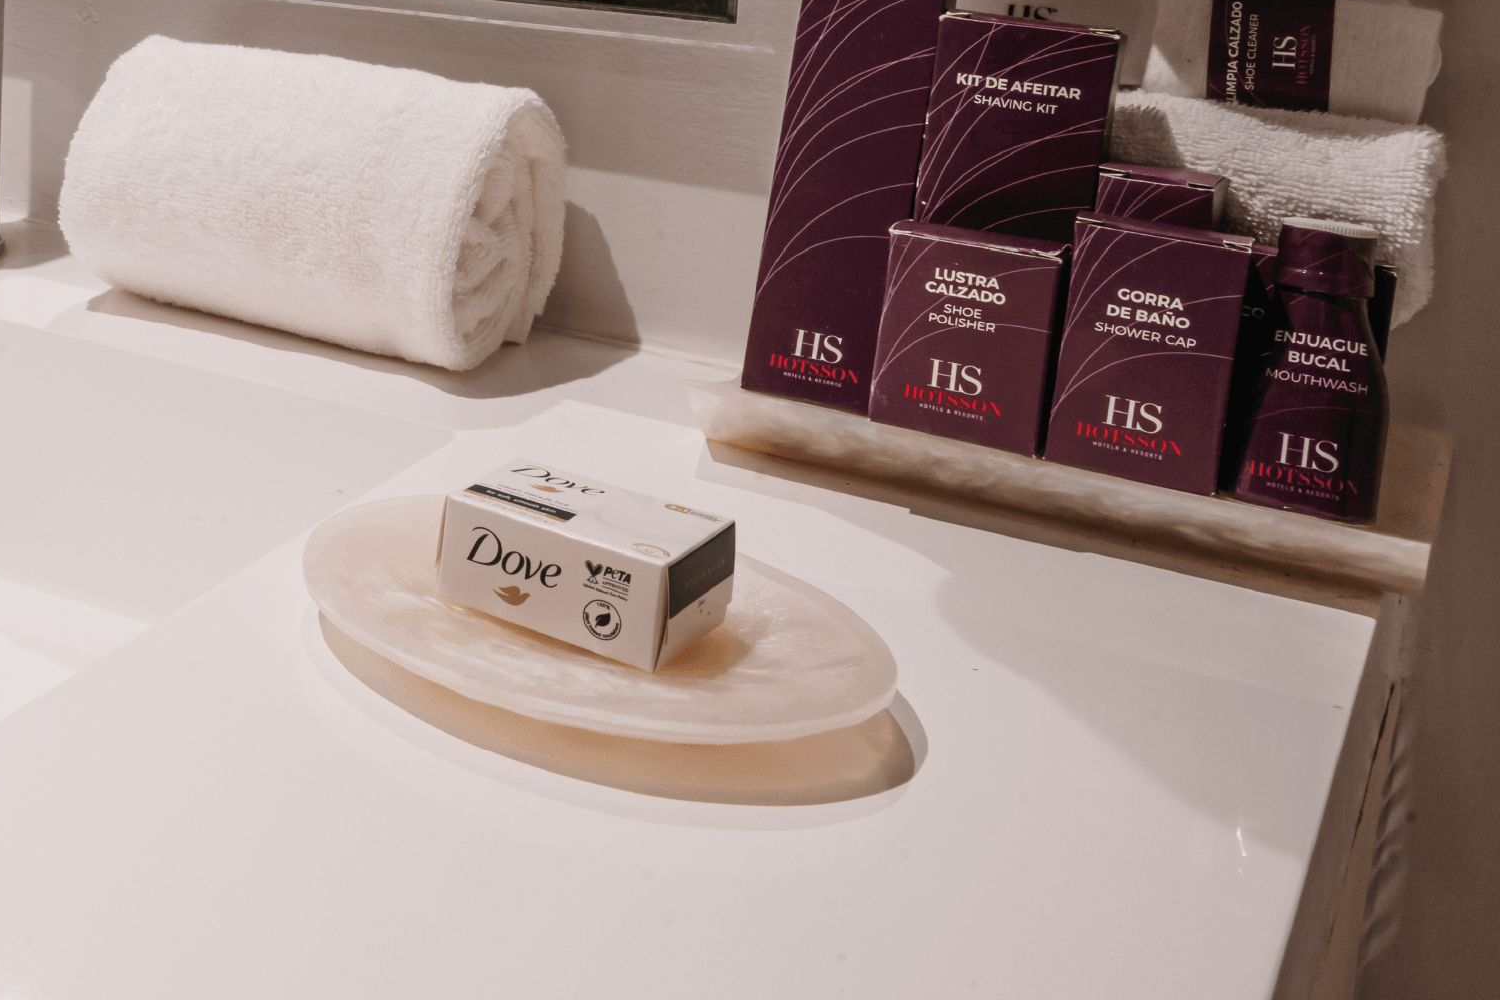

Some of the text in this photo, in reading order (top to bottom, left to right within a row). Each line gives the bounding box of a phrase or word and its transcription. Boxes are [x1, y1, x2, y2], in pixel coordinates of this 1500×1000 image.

[1228, 1, 1243, 58] CALZADO
[1245, 13, 1260, 91] SHOE CLEANER
[1271, 35, 1298, 69] HS
[956, 72, 1081, 100] KIT DE AFEITAR
[974, 94, 1058, 115] SHAVING KIT
[935, 267, 1000, 289] LUSTRA
[925, 281, 1006, 305] CALZADO
[1117, 288, 1184, 311] GORRA
[928, 312, 996, 333] POLISHER
[943, 304, 982, 319] SHOE
[1106, 304, 1191, 329] DE BAÑO
[790, 328, 843, 364] HS
[1094, 322, 1197, 349] SHOWER CAP
[1274, 330, 1368, 356] ENJUAGUE
[768, 352, 860, 385] HOTSSON
[1288, 350, 1351, 372] BUCAL
[783, 371, 806, 380] HOTELS
[927, 358, 982, 396] HS
[1265, 367, 1368, 395] MOUTHWASH
[903, 383, 1002, 418] HOTSSON
[919, 403, 943, 413] HOTELS
[954, 410, 984, 421] RESORTS
[1101, 395, 1163, 434] HS
[1076, 420, 1183, 457] HOTSSON
[1092, 441, 1120, 451] HOTELS
[1131, 449, 1163, 461] RESORTS
[1276, 431, 1339, 474] HS
[510, 465, 605, 495] Dove
[1249, 458, 1359, 495] HOTSSON
[1266, 481, 1294, 493] HOTELS
[466, 526, 563, 588] Dove
